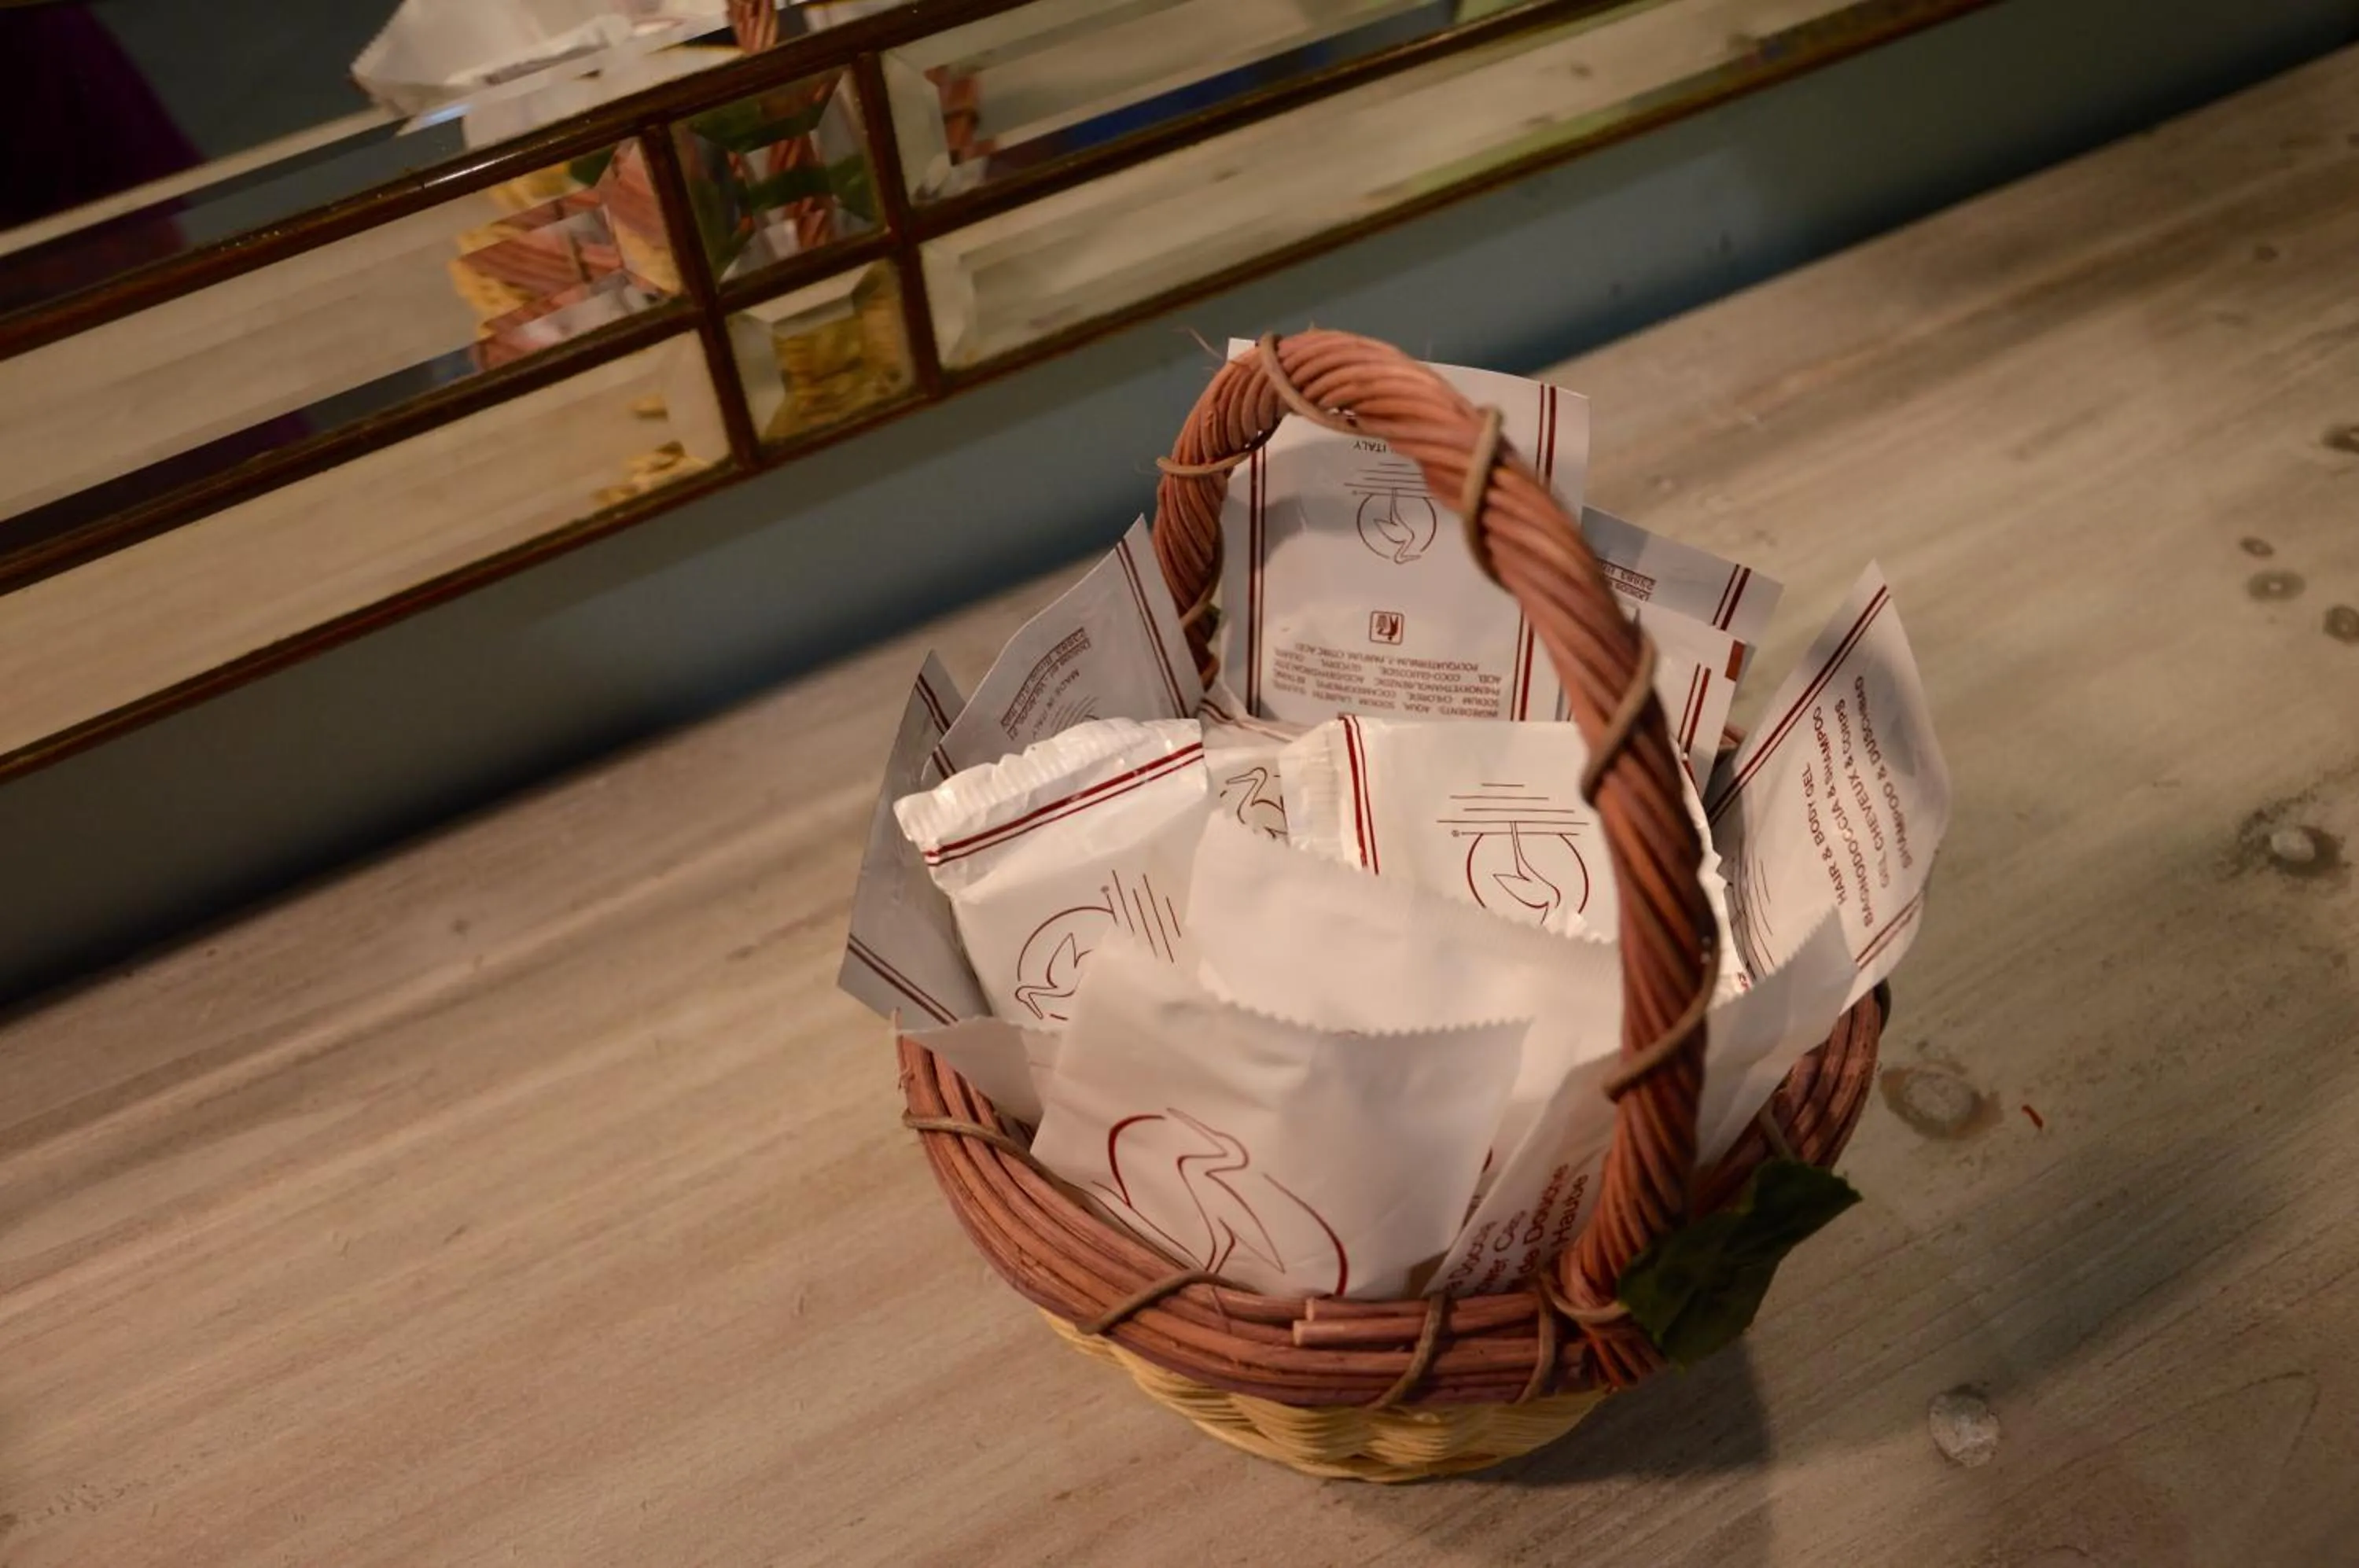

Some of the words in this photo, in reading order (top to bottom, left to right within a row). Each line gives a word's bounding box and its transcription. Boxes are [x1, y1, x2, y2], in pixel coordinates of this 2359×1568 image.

[1353, 440, 1386, 453] ITALY
[1835, 698, 1852, 755] CORPS
[1854, 675, 1881, 765] DUSCHBAD
[1812, 706, 1833, 786] SHAMPOO
[1844, 755, 1854, 769] &
[1801, 763, 1815, 797] GEL
[1827, 786, 1837, 799] &
[1876, 764, 1887, 781] &
[1809, 802, 1825, 847] BODY
[1848, 768, 1885, 852] CHEVEUX
[1883, 782, 1913, 868] SHAMPOO
[1821, 845, 1833, 860] &
[1831, 799, 1874, 928] BAGNODOCCIA
[1878, 850, 1890, 889] GEL
[1828, 862, 1847, 905] HAIR
[1523, 1163, 1570, 1245] Douche
[1550, 1174, 1589, 1248] Haube
